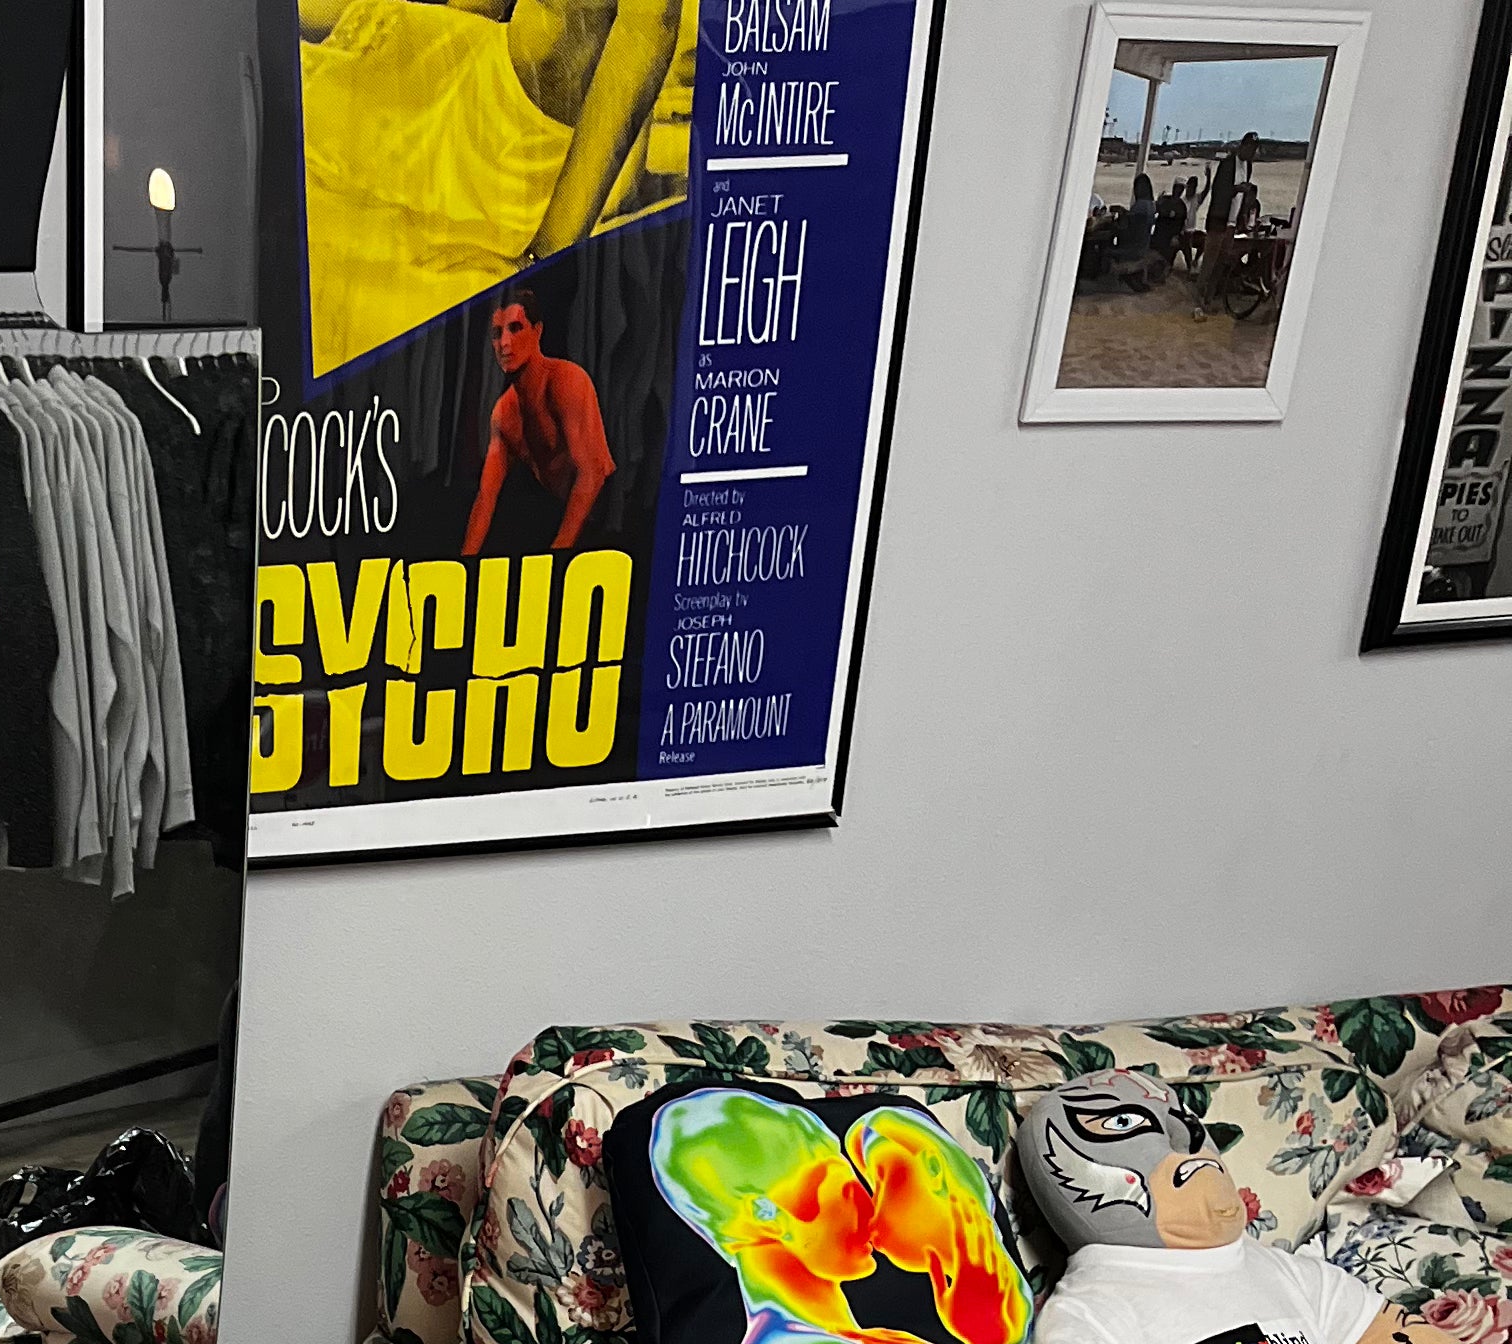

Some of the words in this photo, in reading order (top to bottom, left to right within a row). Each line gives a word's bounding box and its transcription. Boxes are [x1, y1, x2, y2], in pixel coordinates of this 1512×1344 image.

[725, 0, 831, 53] BALSAM
[722, 61, 768, 77] JOHN
[716, 81, 840, 146] McINTIRE
[711, 194, 784, 217] JANET
[699, 219, 808, 346] LEIGH
[698, 353, 713, 367] as
[695, 368, 780, 390] MARION
[689, 392, 777, 458] CRANE
[683, 489, 729, 507] Directed
[1440, 481, 1494, 507] PIES
[682, 511, 742, 528] ALFRED
[1451, 509, 1469, 523] TO
[1458, 524, 1484, 543] OUT
[676, 524, 809, 587] HITCHCOCK
[674, 614, 733, 632] JOSEPH
[666, 629, 765, 689] STEFANO
[660, 703, 674, 746] A
[680, 693, 792, 745] PARAMOUNT
[659, 751, 696, 764] Release
